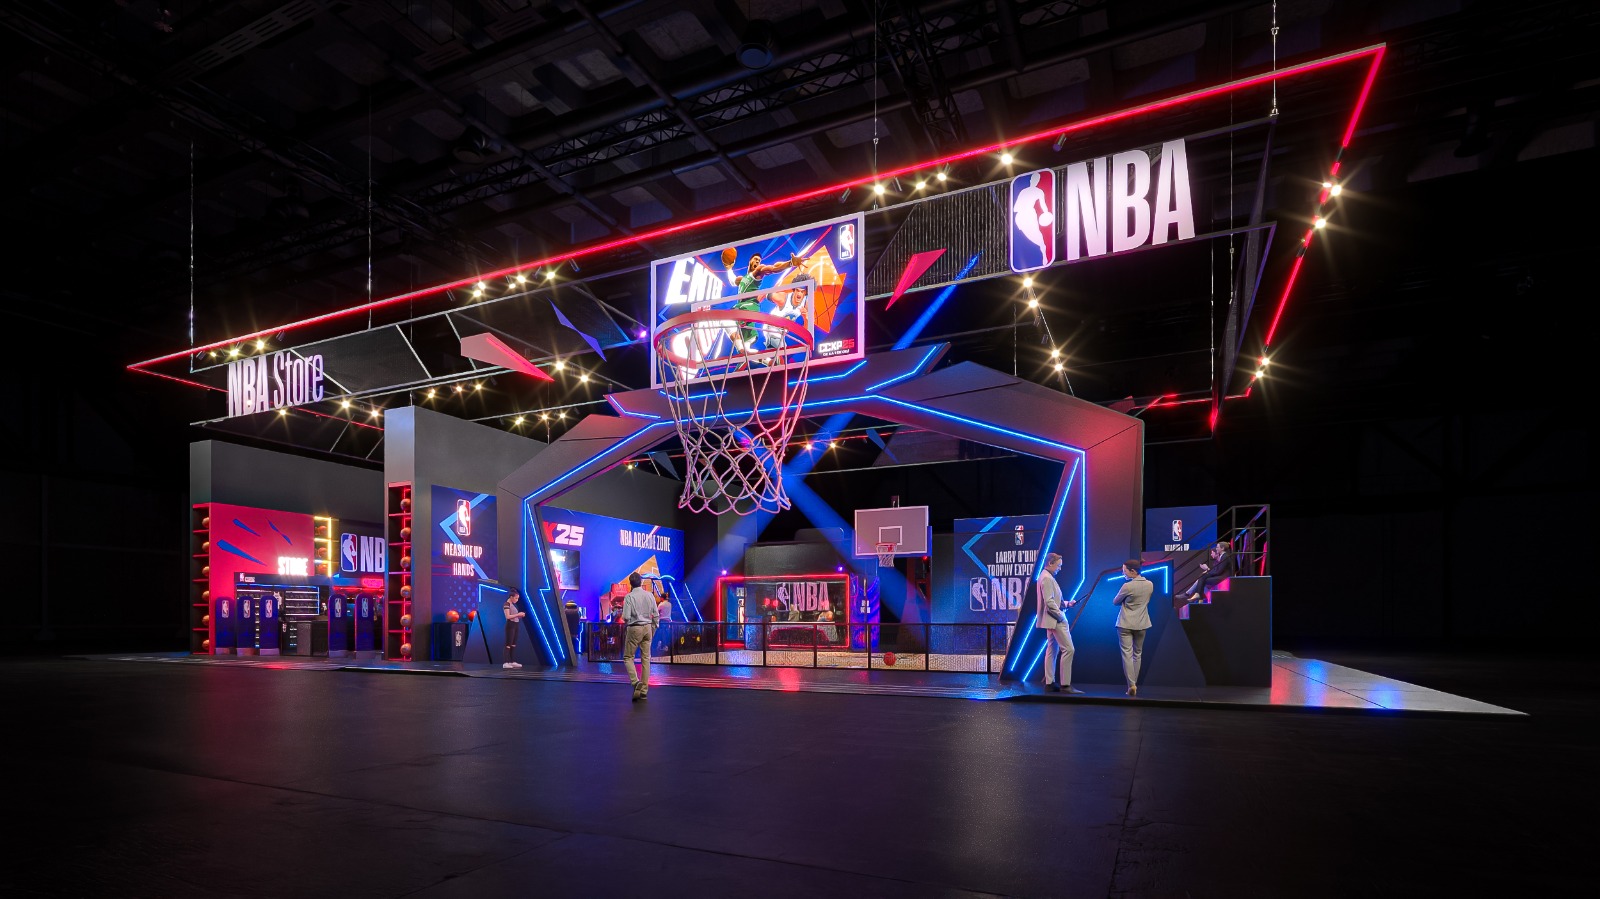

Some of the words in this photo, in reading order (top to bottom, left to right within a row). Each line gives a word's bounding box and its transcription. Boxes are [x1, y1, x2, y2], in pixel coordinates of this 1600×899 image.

[1067, 138, 1195, 261] NBA
[228, 355, 269, 418] NBA
[273, 351, 324, 409] Store
[444, 542, 473, 558] MEASURE
[473, 545, 483, 558] UP
[620, 529, 633, 547] NBA
[656, 535, 671, 552] ZONE
[995, 551, 1016, 564] LARRY
[453, 563, 475, 577] HANDS
[987, 564, 1013, 577] TROPHY
[793, 582, 830, 611] NBA
